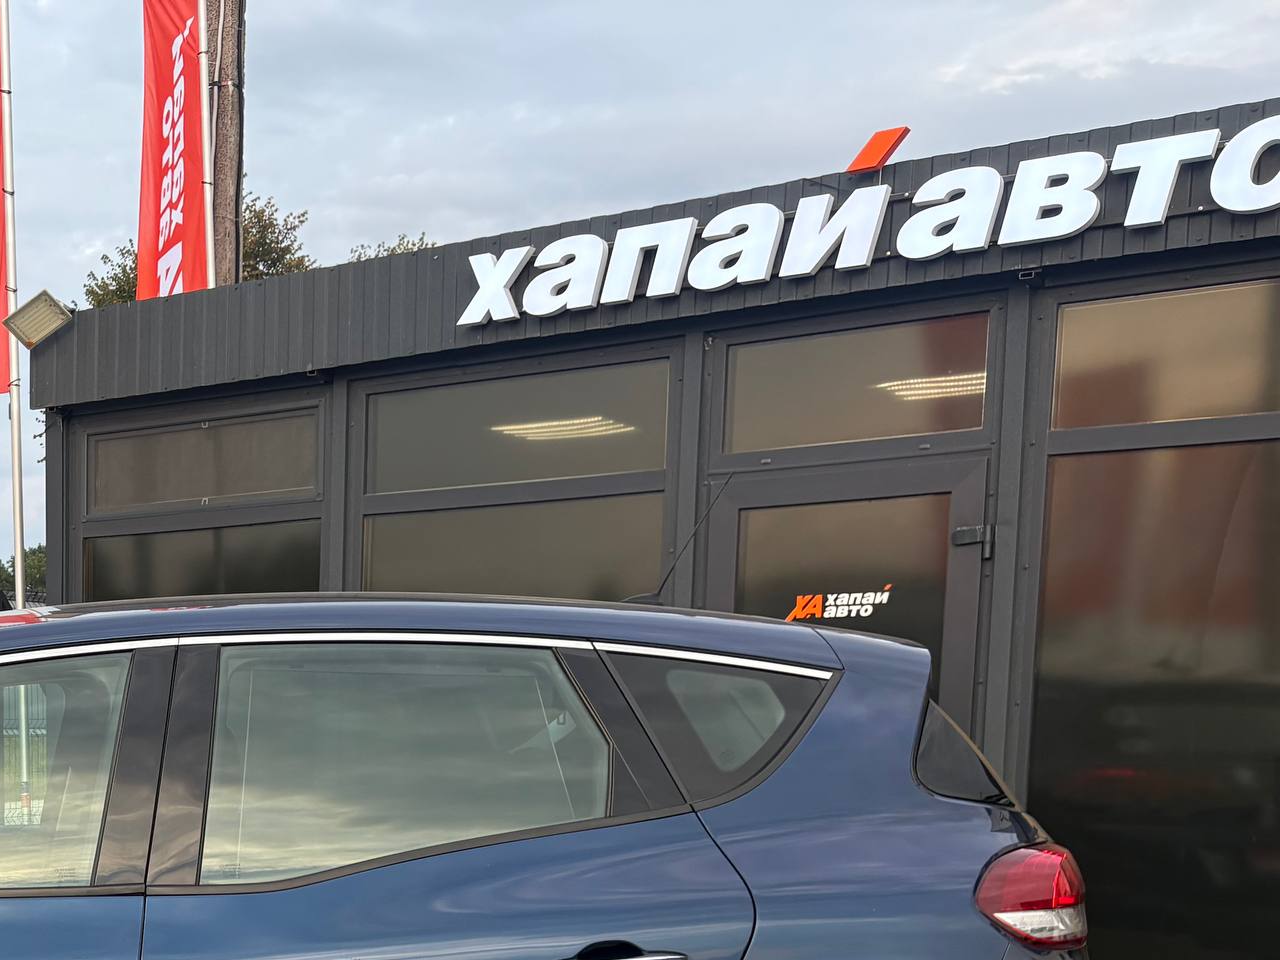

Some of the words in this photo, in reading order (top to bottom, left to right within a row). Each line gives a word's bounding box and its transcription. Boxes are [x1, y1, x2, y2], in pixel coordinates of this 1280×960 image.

[456, 126, 911, 327] хапай
[896, 115, 1280, 260] авто
[825, 584, 892, 605] хапай
[823, 605, 873, 618] авто
